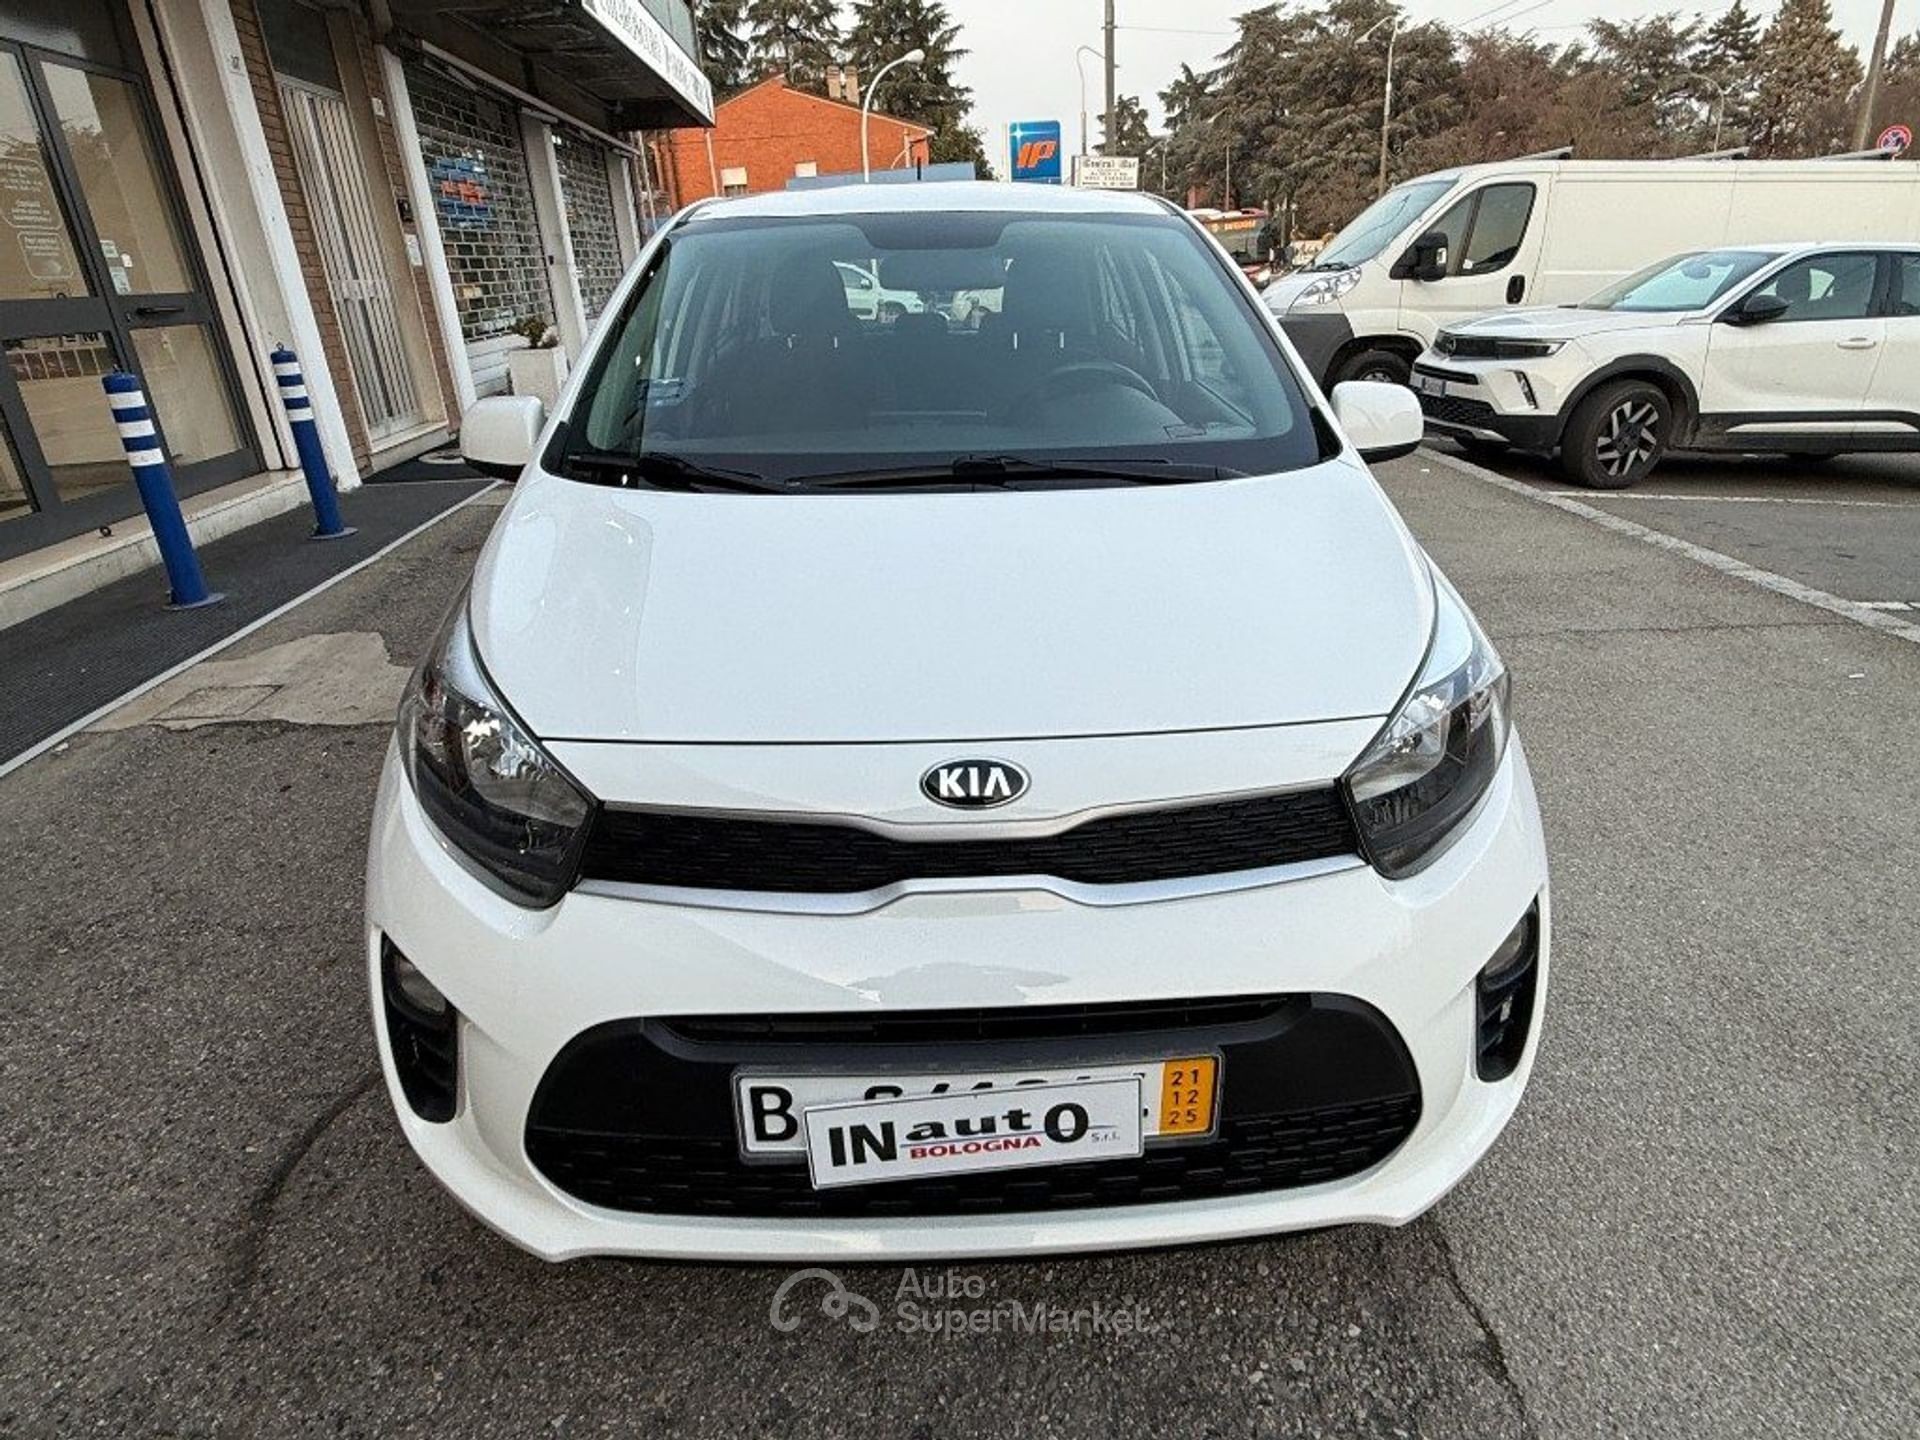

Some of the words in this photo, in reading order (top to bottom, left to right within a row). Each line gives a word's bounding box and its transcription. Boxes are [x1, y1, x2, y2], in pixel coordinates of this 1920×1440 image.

[938, 766, 1012, 798] KIA
[1171, 1068, 1200, 1087] 21
[1172, 1089, 1200, 1106] 12
[749, 1085, 798, 1142] B
[1168, 1107, 1198, 1126] 25
[909, 1136, 1042, 1159] BOLOGNA
